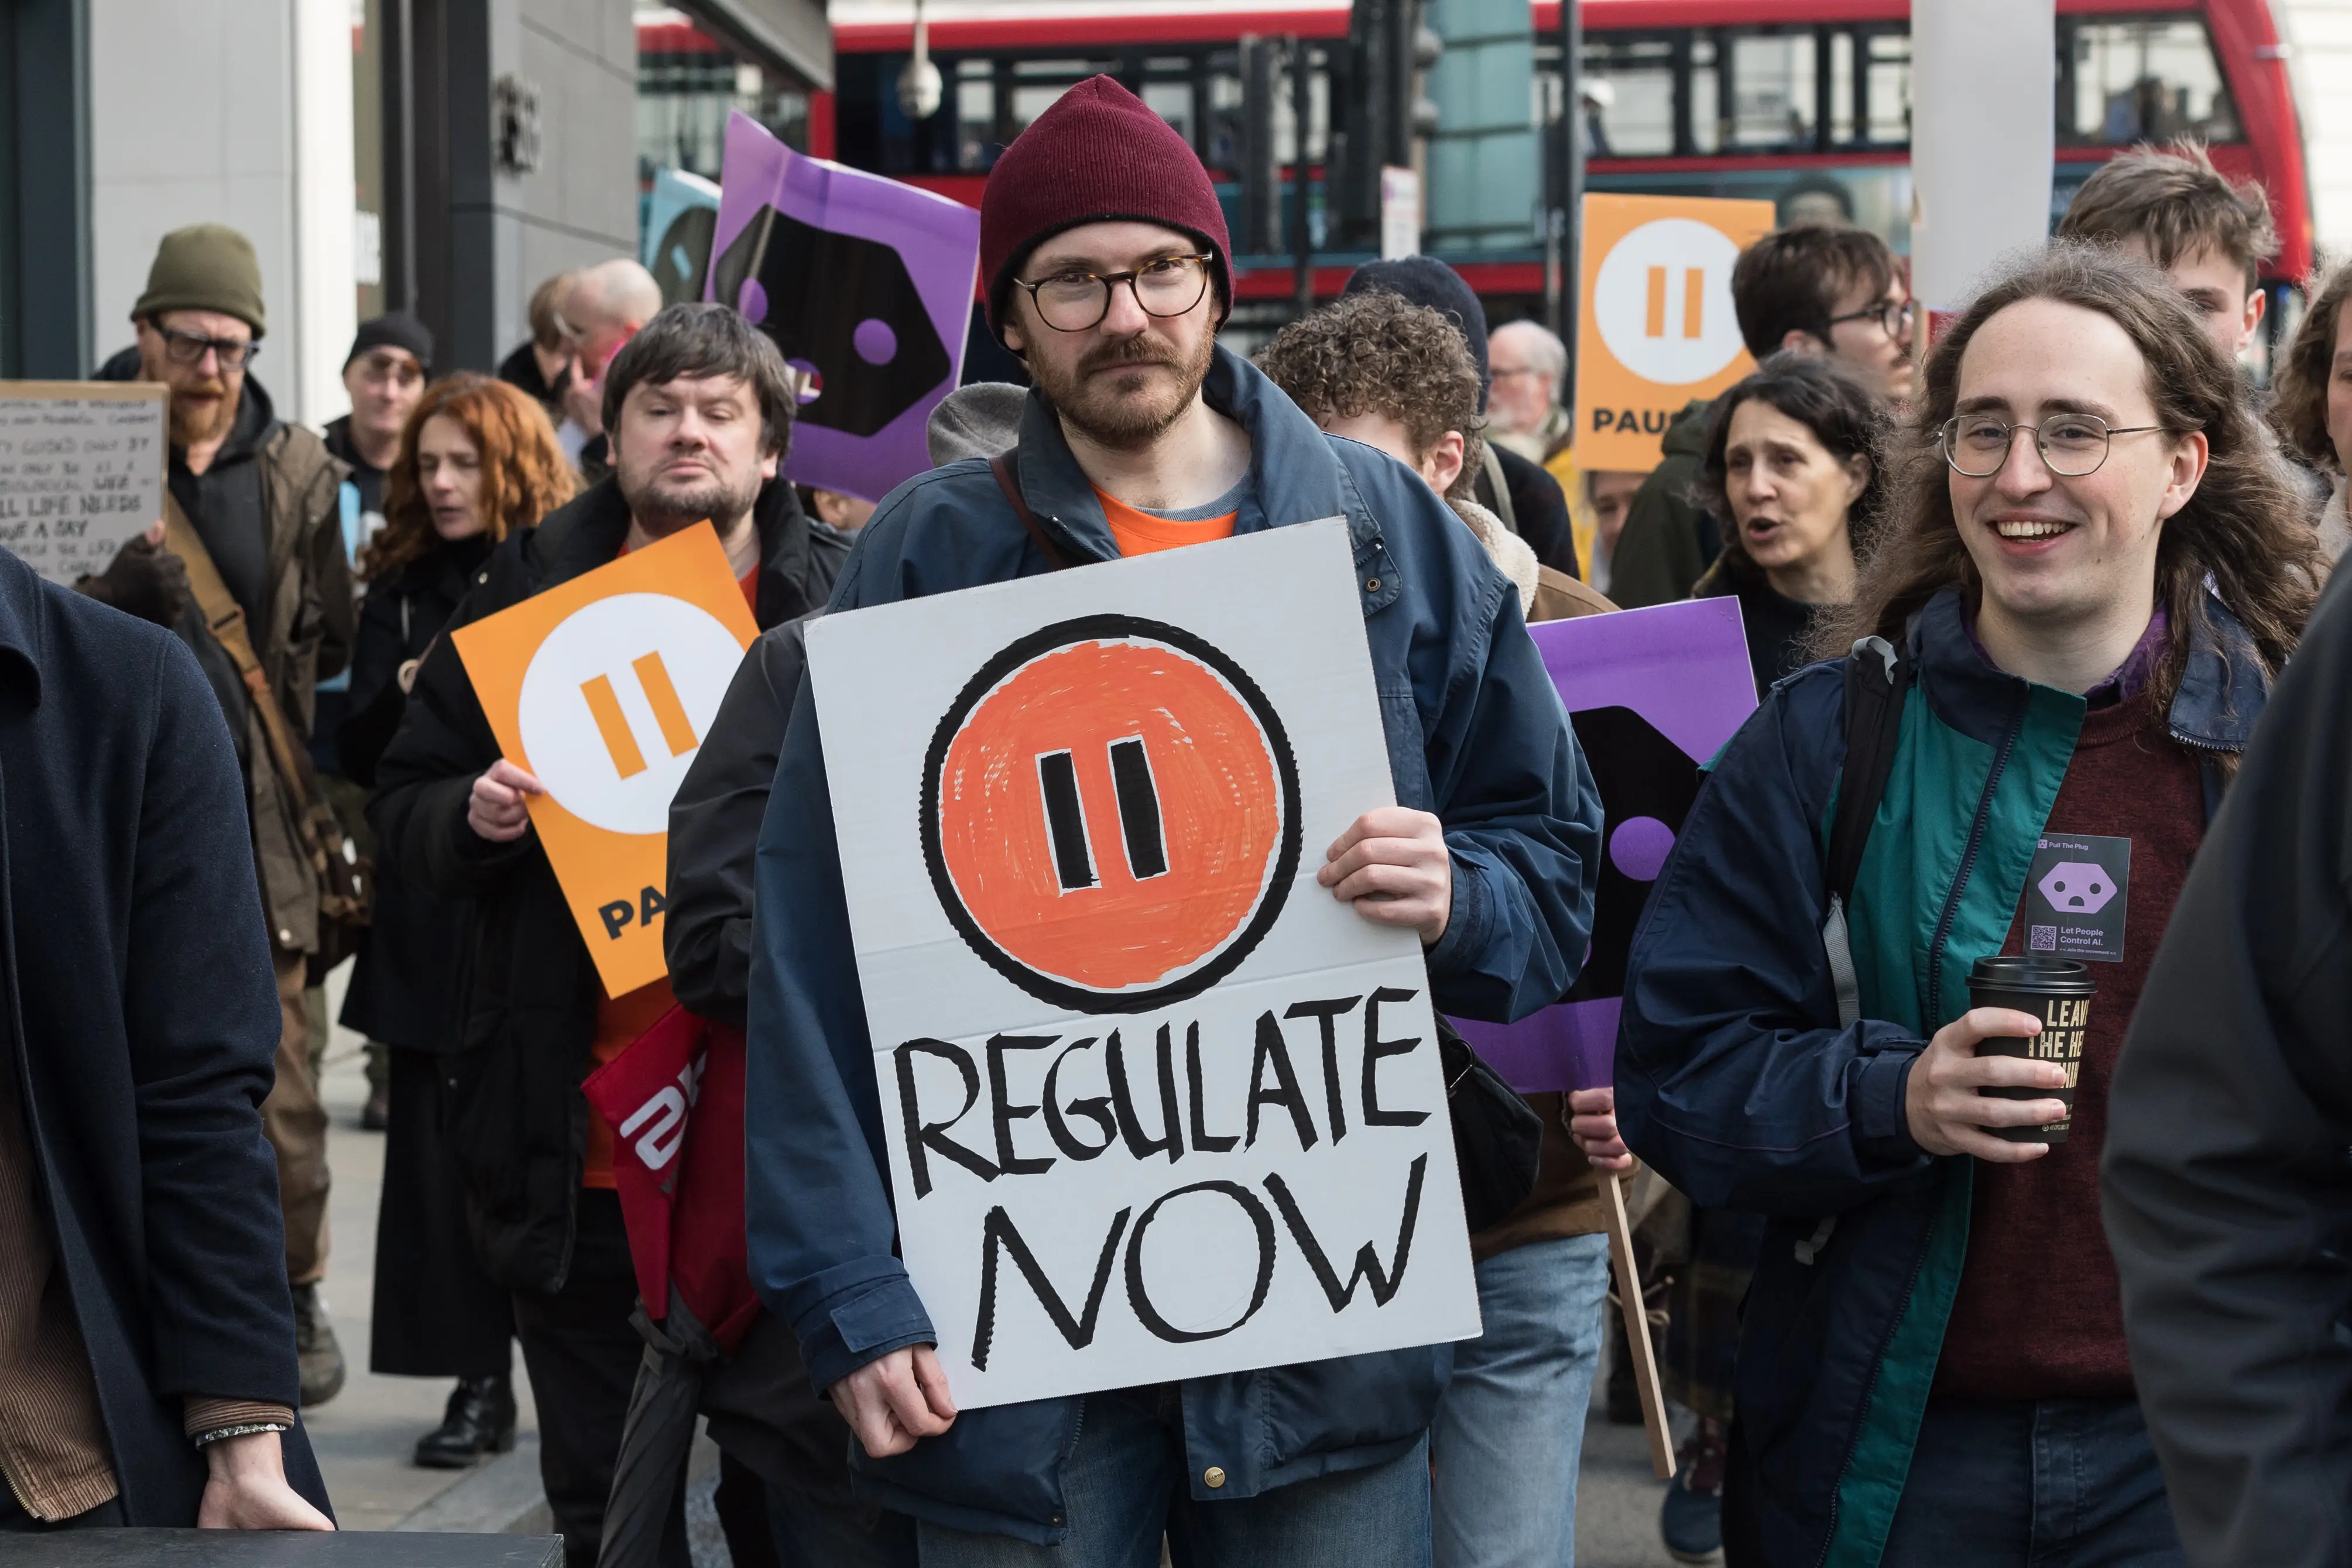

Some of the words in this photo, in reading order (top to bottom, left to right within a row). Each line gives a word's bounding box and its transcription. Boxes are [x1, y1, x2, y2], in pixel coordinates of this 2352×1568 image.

[1593, 408, 1668, 434] PAU
[78, 493, 143, 516] NEEDS
[598, 885, 667, 941] PA
[2060, 936, 2090, 945] Control
[2076, 927, 2104, 937] People
[2047, 999, 2090, 1027] LEAV
[893, 987, 1431, 1200] REGULATE
[971, 1152, 1428, 1374] NOW
